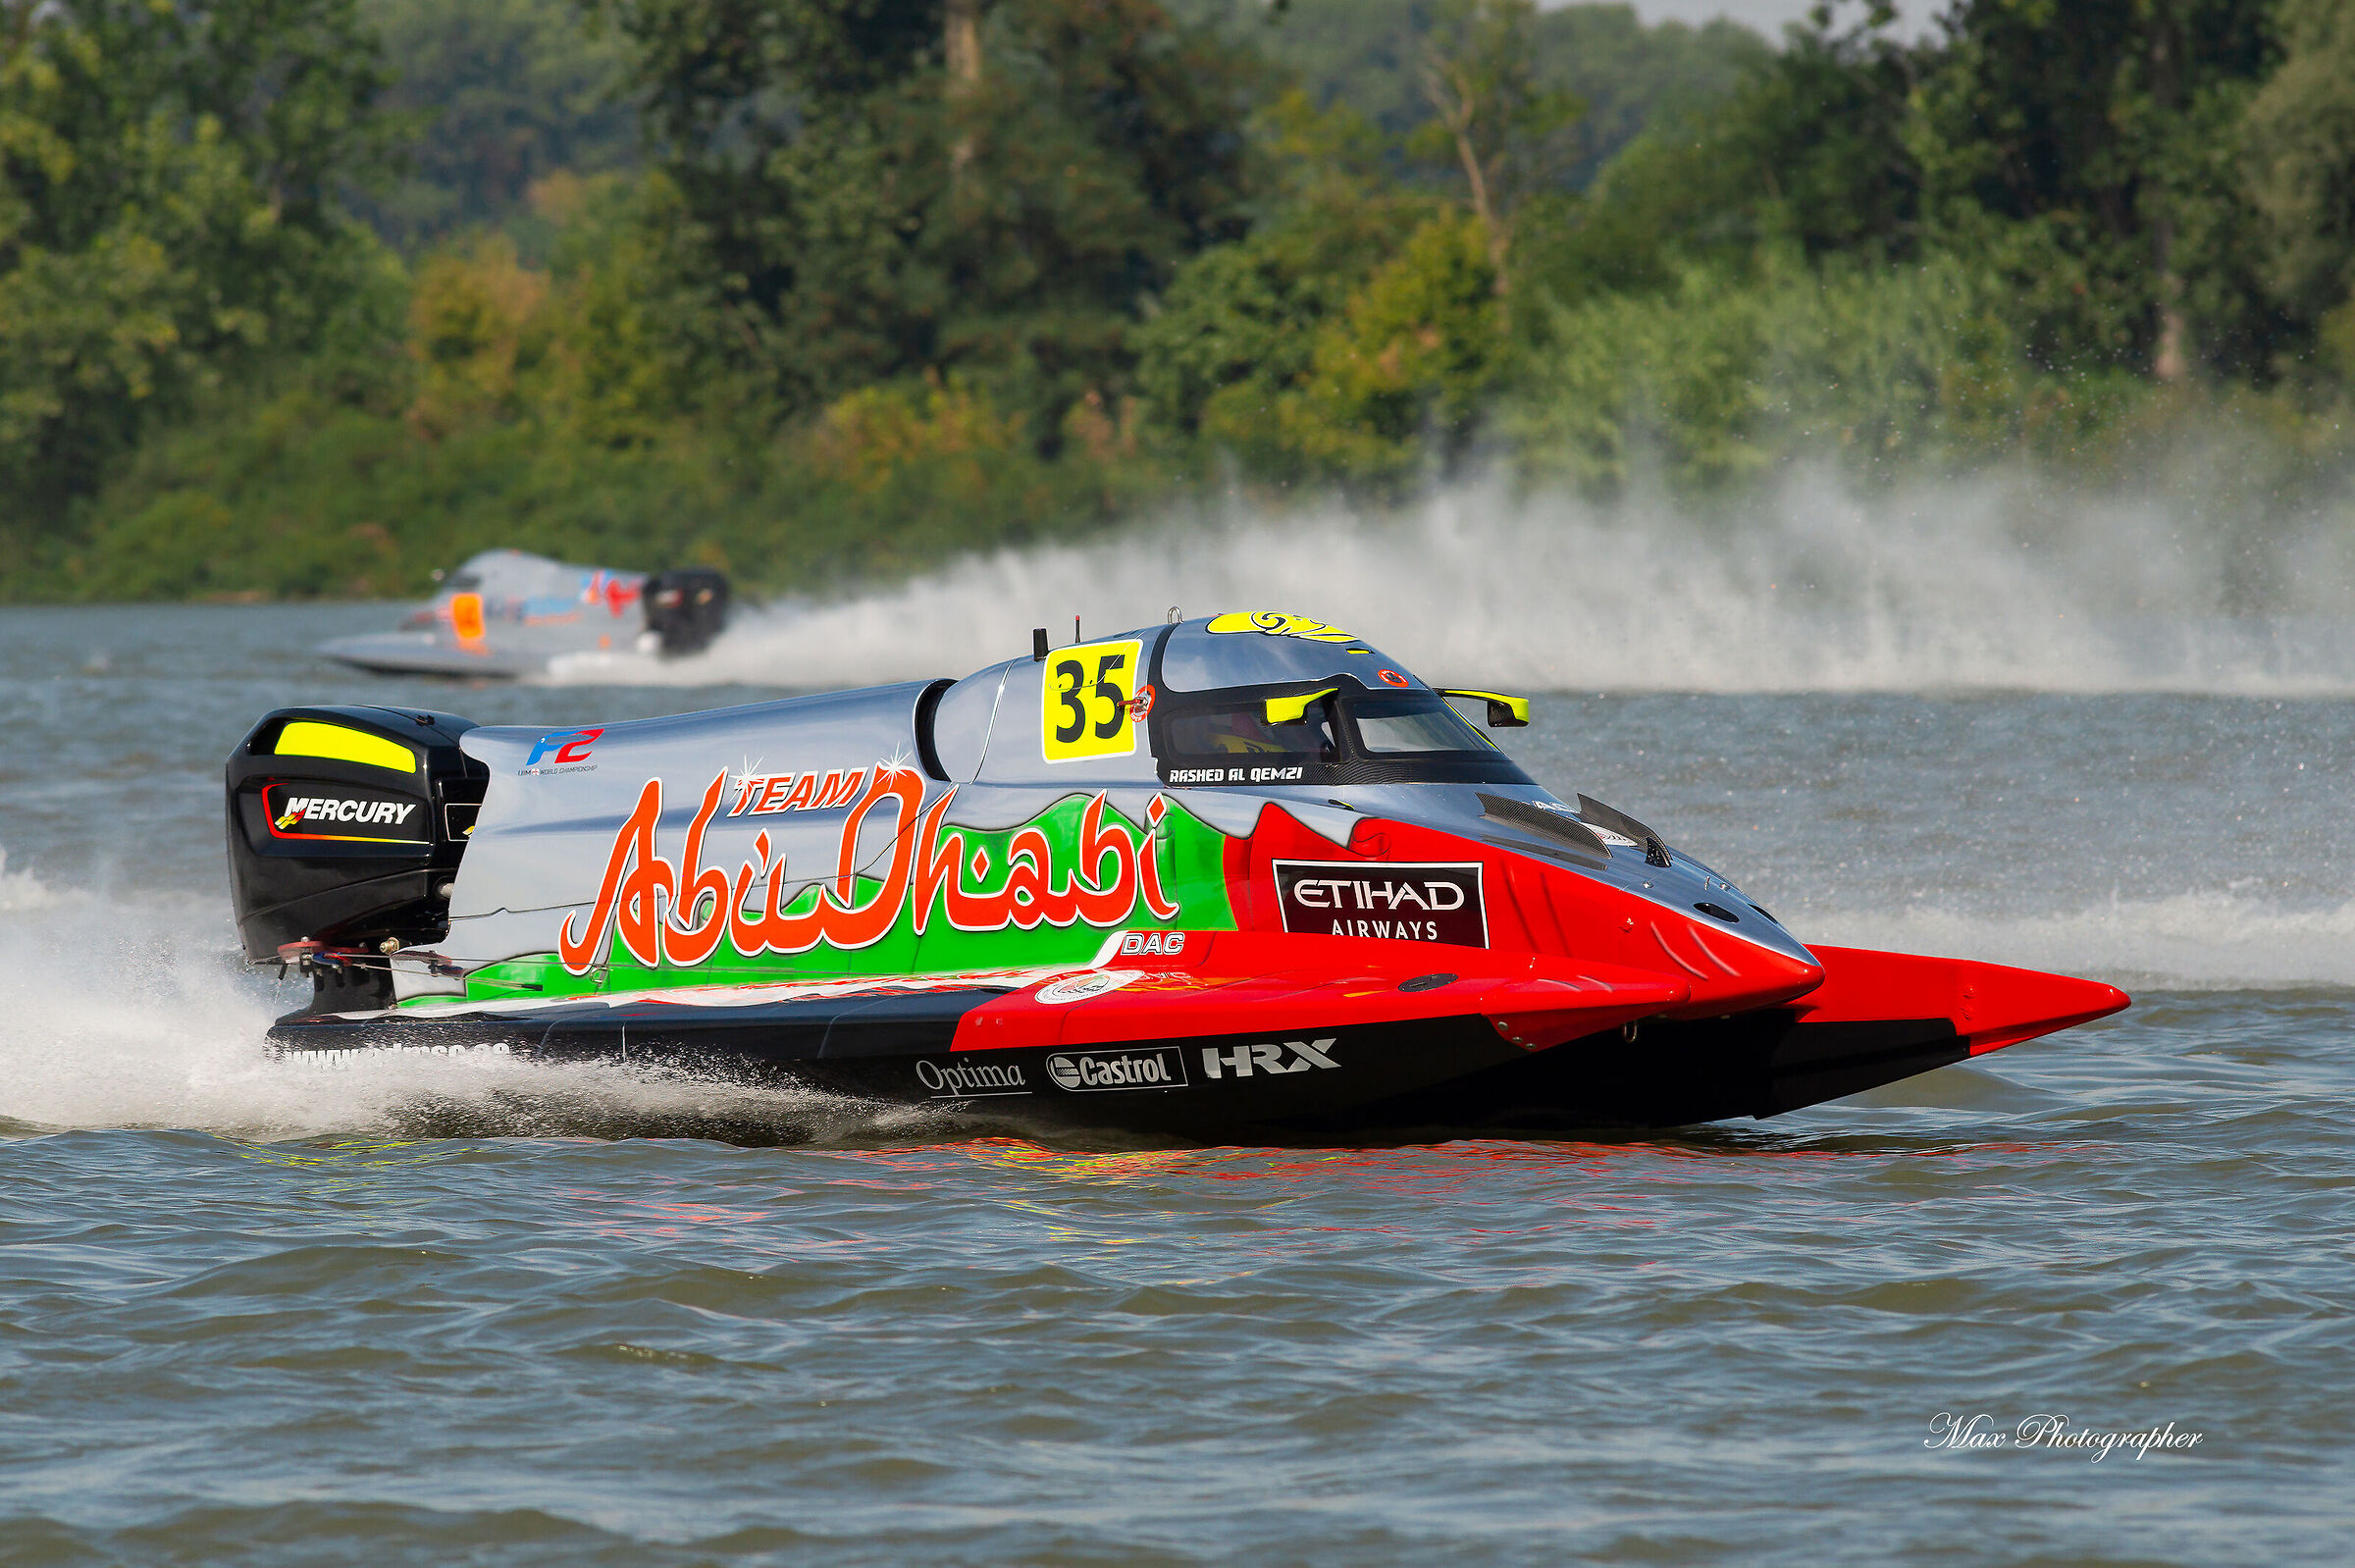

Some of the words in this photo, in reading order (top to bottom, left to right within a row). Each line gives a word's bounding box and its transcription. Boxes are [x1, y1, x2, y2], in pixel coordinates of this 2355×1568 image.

[1055, 654, 1125, 743] 35
[526, 728, 604, 765] F2
[1170, 768, 1225, 783] RASHED
[1228, 768, 1246, 781] AL
[1249, 766, 1303, 782] QEMZI
[726, 767, 868, 817] TEAM
[284, 797, 416, 825] MERCURY
[557, 765, 822, 976] Abu
[821, 760, 1180, 951] Dhabi
[1293, 879, 1465, 911] ETIHAD
[1121, 932, 1185, 956] DAC
[1332, 918, 1438, 940] AIRWAYS
[916, 1057, 1026, 1097] Optima
[1079, 1053, 1172, 1086] Castrol
[1201, 1037, 1342, 1078] HRX
